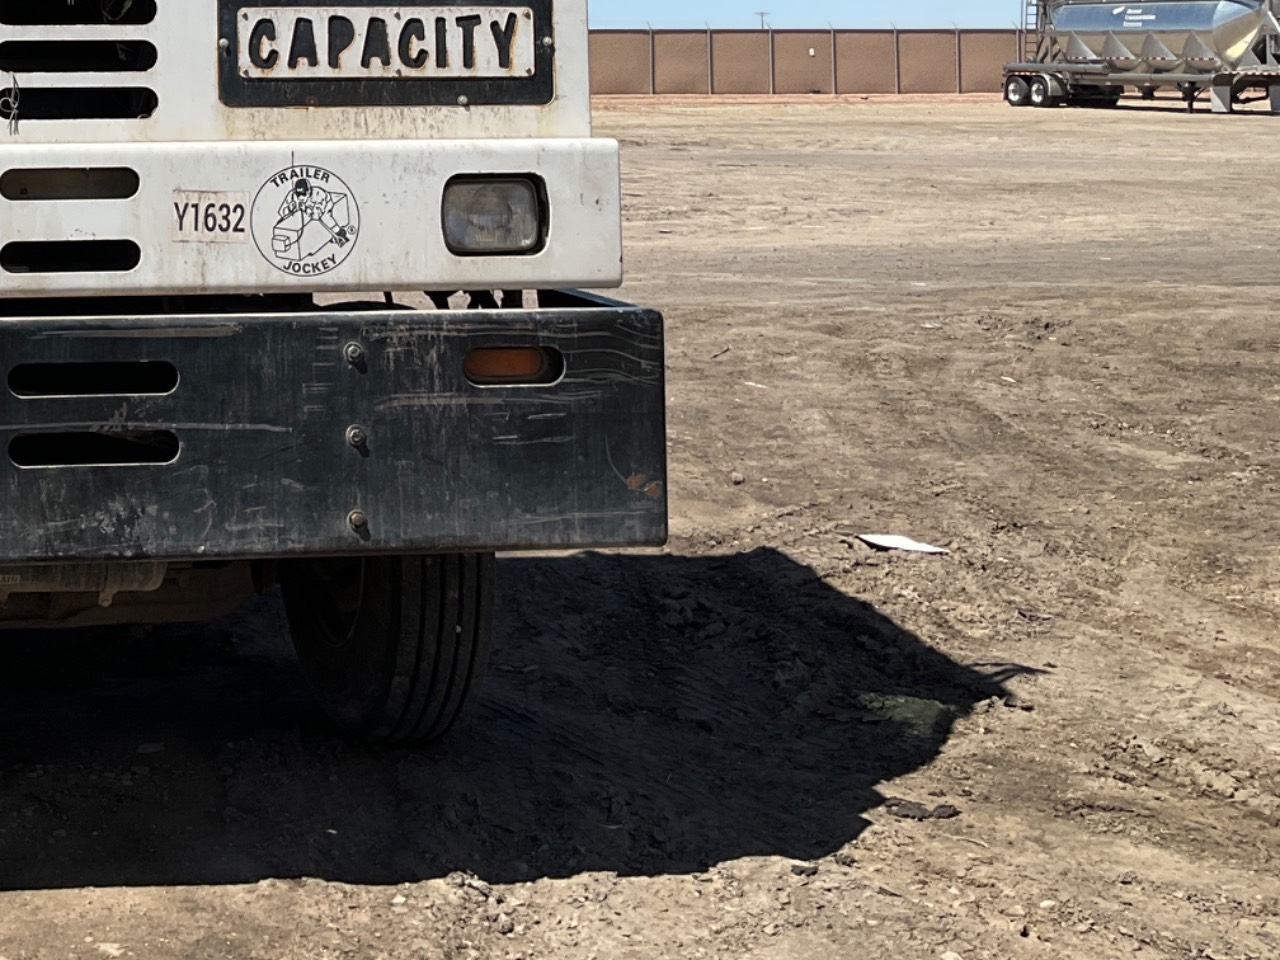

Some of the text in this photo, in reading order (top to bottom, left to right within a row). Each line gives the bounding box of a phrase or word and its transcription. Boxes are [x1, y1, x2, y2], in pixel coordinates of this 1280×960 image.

[248, 12, 517, 70] CAPACITY
[269, 167, 330, 188] TRAILER
[173, 202, 245, 233] Y1632
[283, 253, 337, 274] JOCKEY
